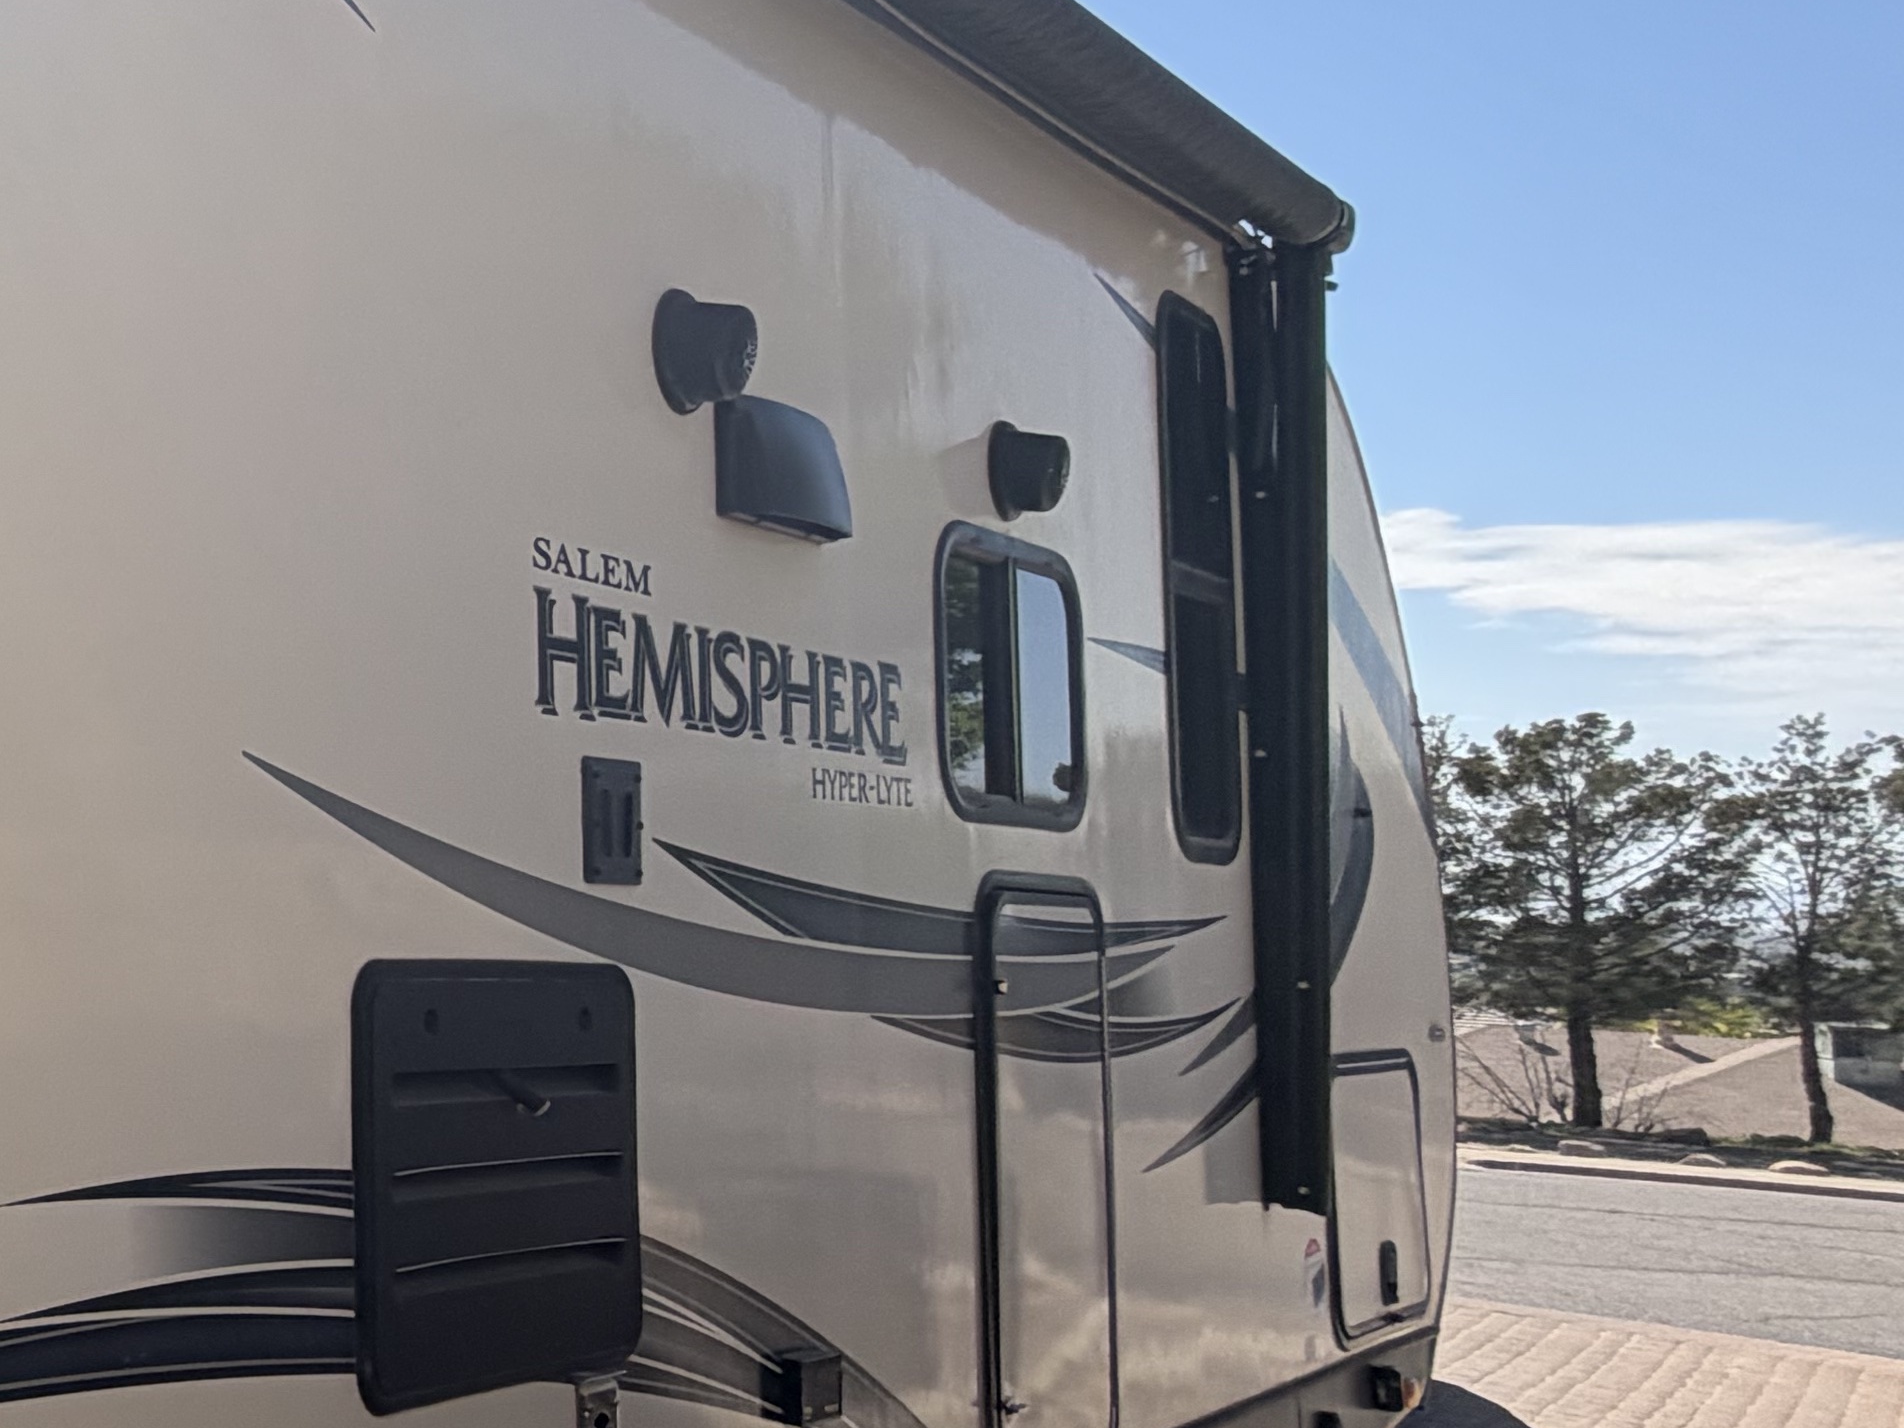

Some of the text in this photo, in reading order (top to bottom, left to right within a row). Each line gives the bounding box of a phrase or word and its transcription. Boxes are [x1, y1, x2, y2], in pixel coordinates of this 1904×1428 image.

[532, 536, 652, 597] SALEM
[532, 584, 908, 767] HEMISPHERE
[811, 767, 914, 807] HYPER-LYTE
